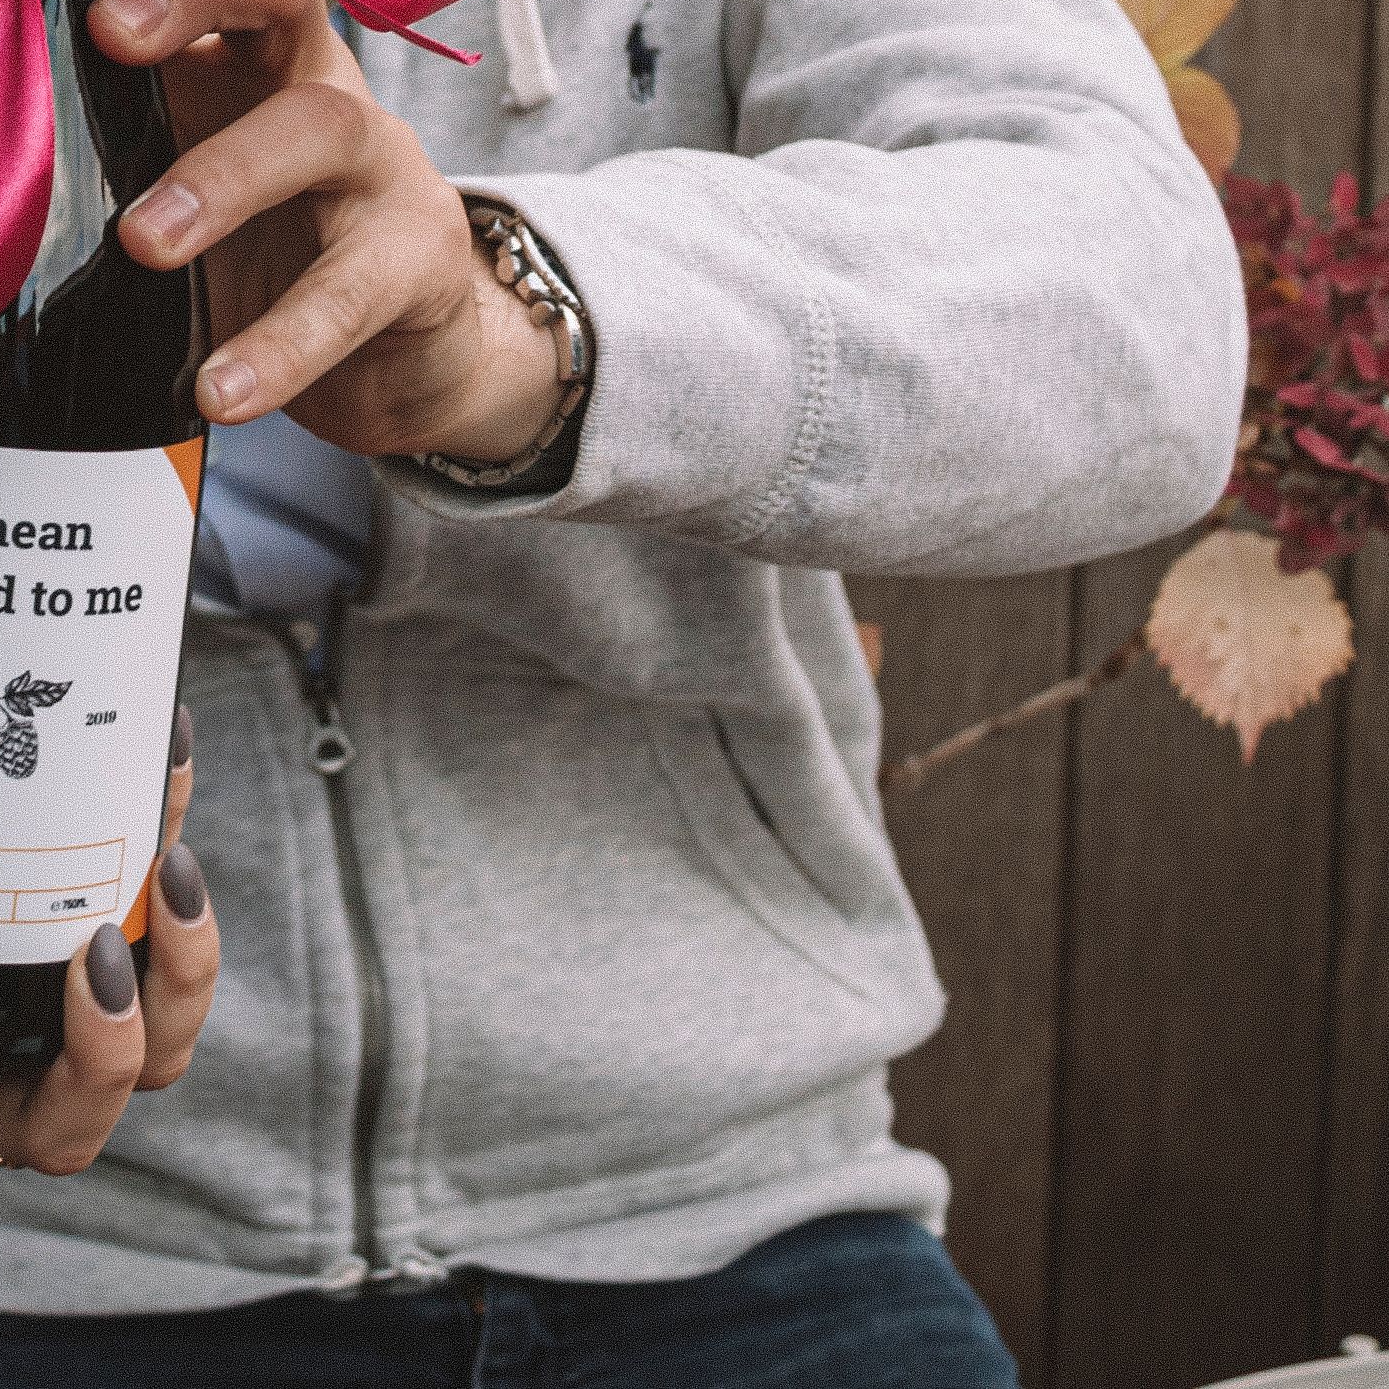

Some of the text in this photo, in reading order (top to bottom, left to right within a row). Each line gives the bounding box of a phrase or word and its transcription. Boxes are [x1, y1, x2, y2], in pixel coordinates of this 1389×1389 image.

[31, 582, 73, 616] to
[84, 584, 142, 616] me
[86, 711, 116, 726] 2019
